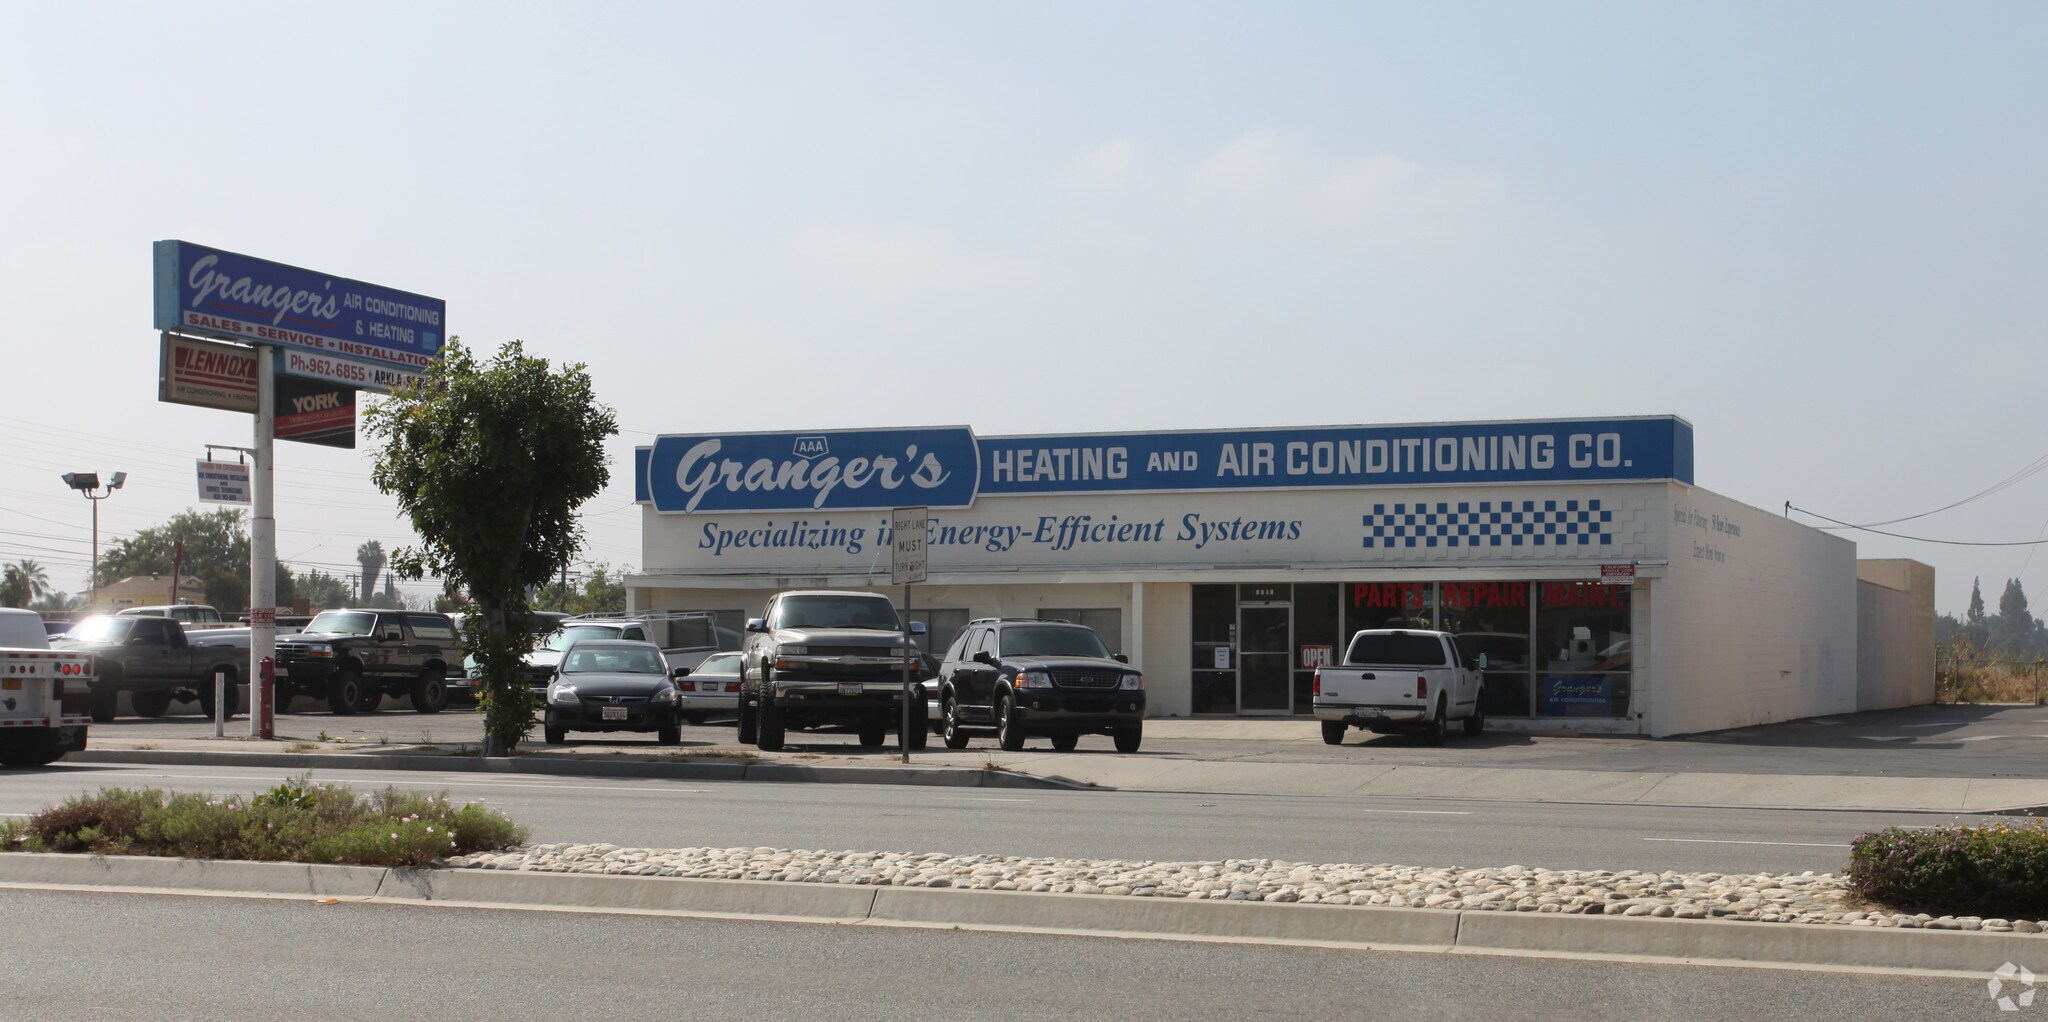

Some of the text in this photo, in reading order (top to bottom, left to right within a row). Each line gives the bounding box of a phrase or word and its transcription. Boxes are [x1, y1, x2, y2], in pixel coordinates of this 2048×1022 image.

[189, 254, 340, 326] Granger's
[343, 292, 439, 326] AIR CONDITIONING
[188, 313, 242, 333] SALES
[257, 326, 324, 348] SERVICE
[355, 319, 414, 344] & HEATING
[185, 348, 251, 378] LENNOX
[176, 385, 256, 402] AIR CONDITIONING HEATING
[292, 391, 340, 414] YORK
[799, 441, 824, 453] AAA
[993, 433, 1633, 482] HEATING AND AIR CONDITIONING CO.
[676, 438, 951, 514] Granger's
[699, 520, 866, 556] Specializing
[928, 514, 1165, 553] Energy-Efficient
[1177, 513, 1302, 549] Systems
[895, 519, 926, 531] RIGHT LANE
[899, 539, 922, 552] MUST
[895, 562, 909, 573] TURN
[1354, 581, 1625, 609] PARTS REPAIR MAINT.
[1303, 648, 1331, 667] OPEN
